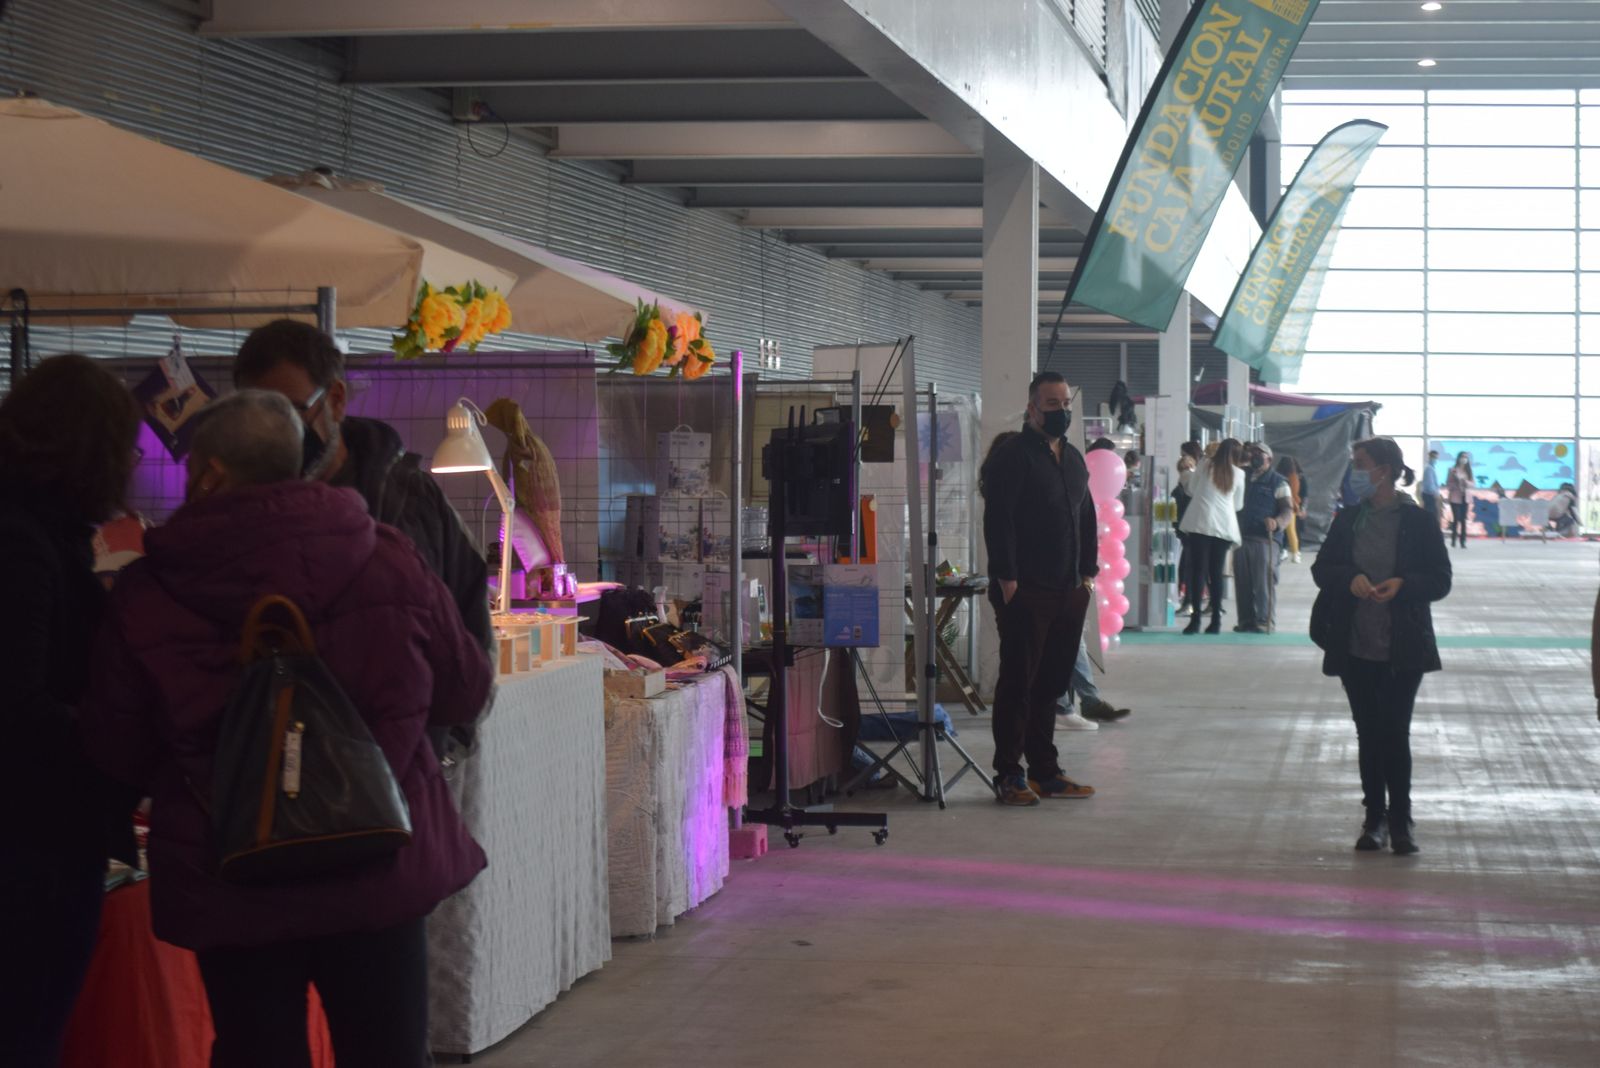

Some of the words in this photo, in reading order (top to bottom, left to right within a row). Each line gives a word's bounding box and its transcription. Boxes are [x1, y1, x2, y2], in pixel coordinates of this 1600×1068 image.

[1108, 3, 1242, 245] FUNDACION
[1250, 37, 1291, 103] ZAMORA
[1145, 164, 1208, 254] CAJA
[1188, 27, 1272, 154] RURAL
[1234, 193, 1308, 318] FUNDACION
[1252, 277, 1286, 326] CAJA
[1278, 206, 1326, 274] RURAL
